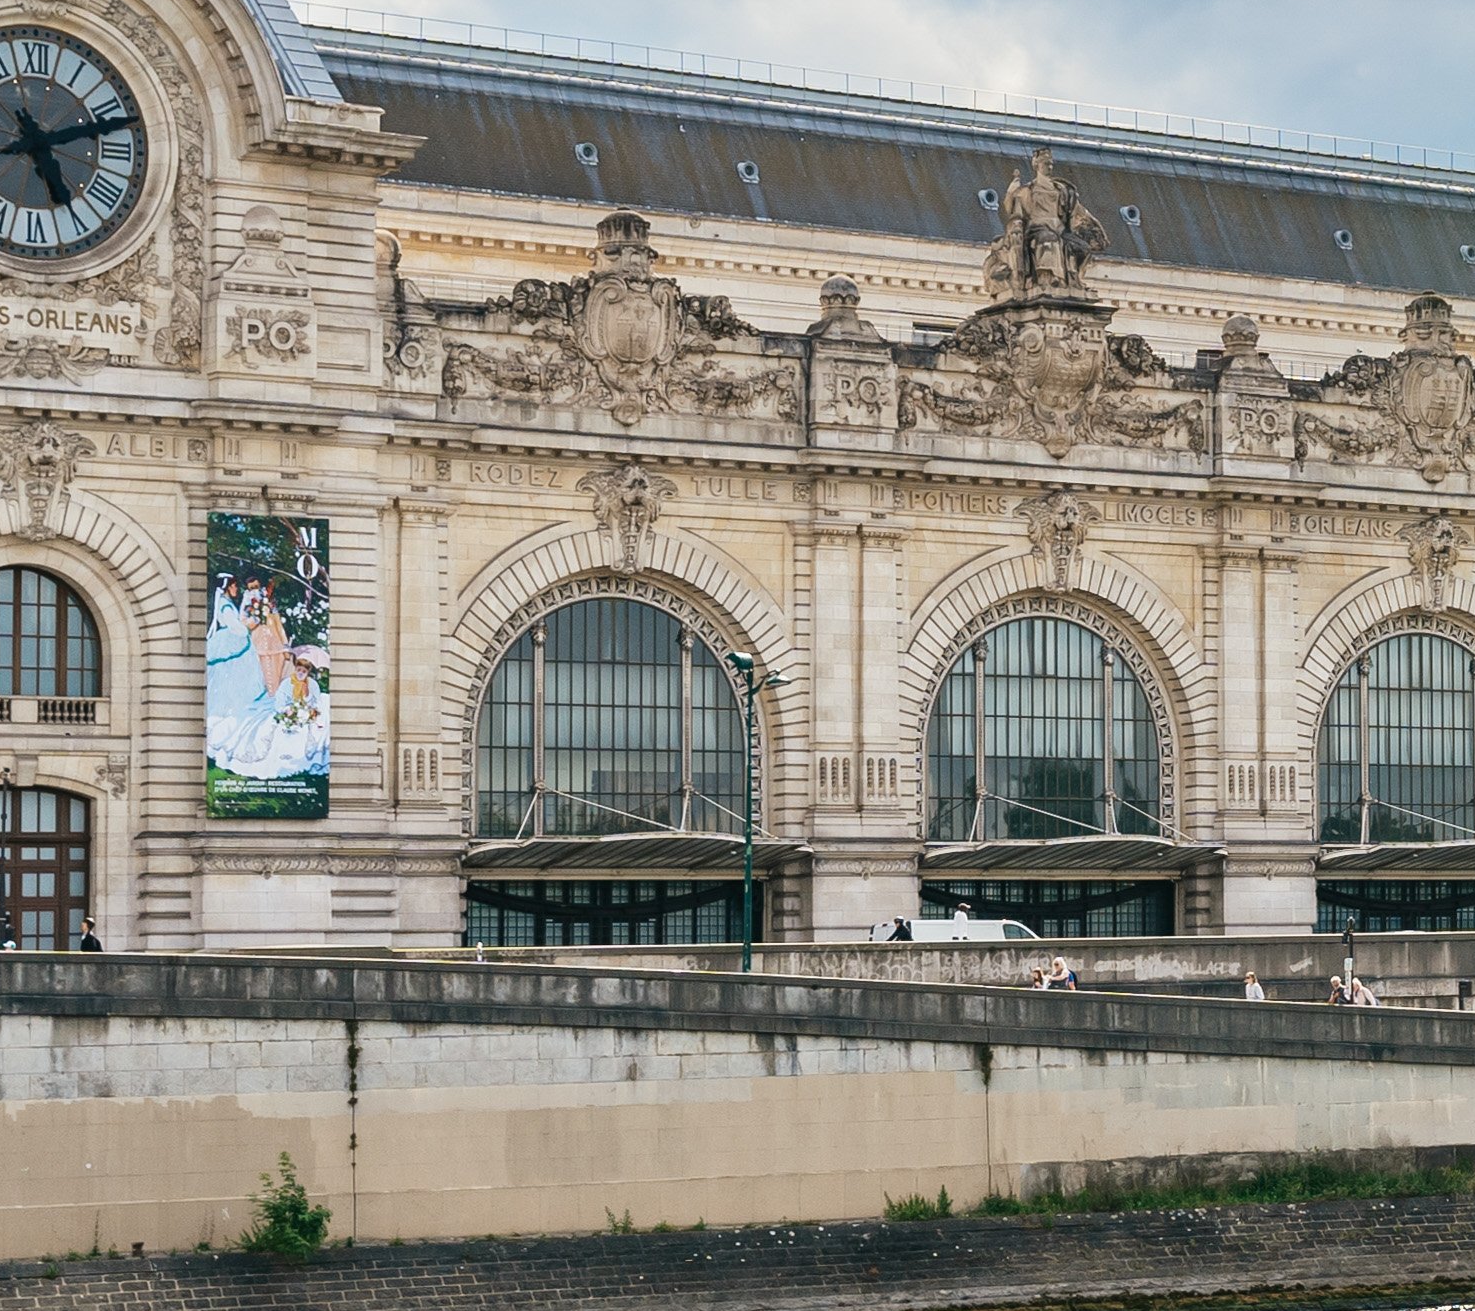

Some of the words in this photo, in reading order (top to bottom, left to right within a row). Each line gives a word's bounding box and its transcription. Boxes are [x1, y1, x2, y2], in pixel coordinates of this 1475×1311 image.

[22, 42, 49, 75] XII
[67, 60, 87, 88] I
[101, 141, 131, 162] III
[26, 211, 47, 243] VI
[241, 318, 297, 350] PO
[836, 374, 880, 404] PO
[1240, 408, 1279, 434] PO
[106, 433, 179, 459] ALBI
[469, 461, 564, 488] RODEZ
[690, 476, 777, 501] TULLE
[909, 491, 1009, 515] POITIERS
[298, 526, 318, 549] M
[1304, 515, 1393, 538] ORLEANS
